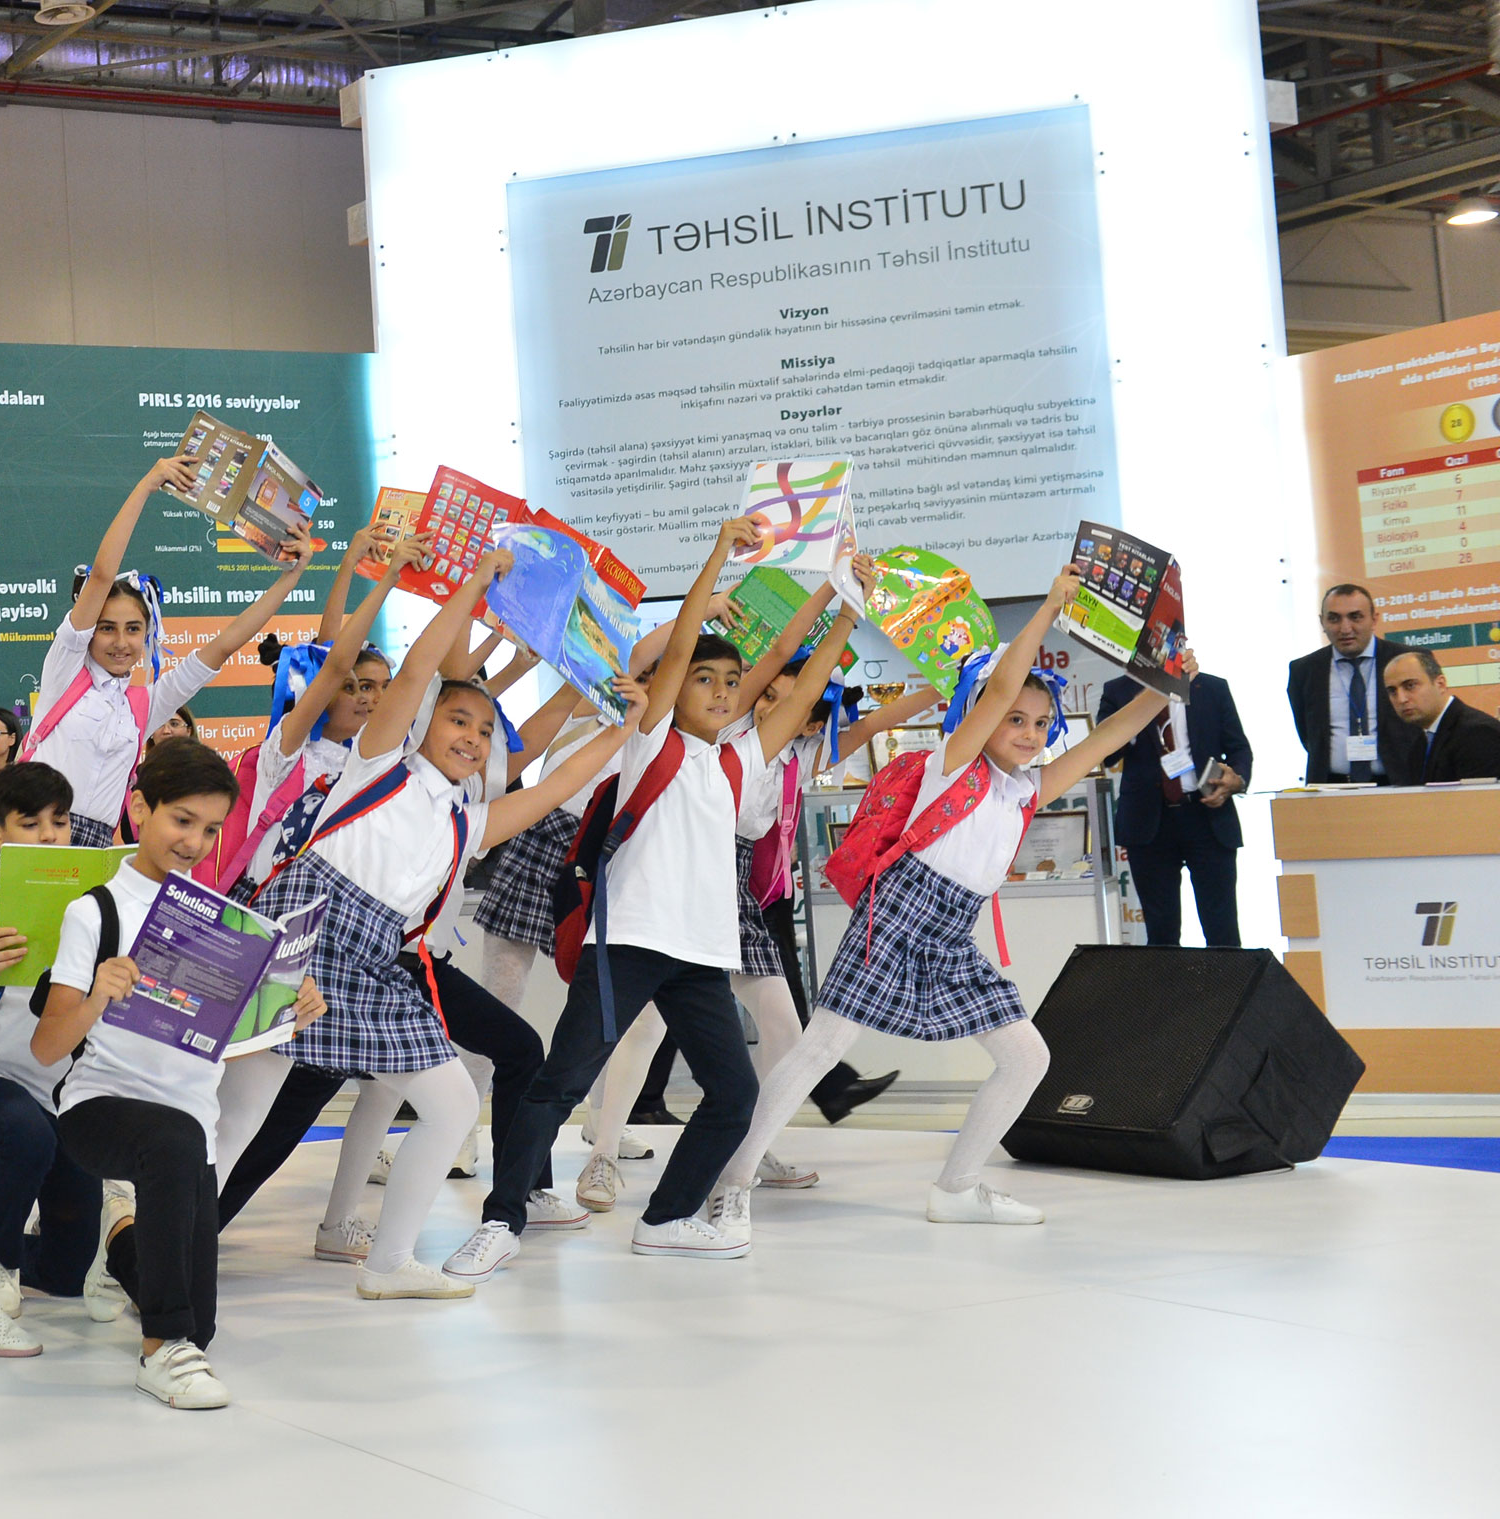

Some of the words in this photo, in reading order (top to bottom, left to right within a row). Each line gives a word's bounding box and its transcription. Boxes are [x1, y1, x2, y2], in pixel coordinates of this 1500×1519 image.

[647, 207, 794, 255] TƏHSİL
[805, 179, 1026, 236] İNSTİTUTU
[588, 278, 702, 304] Azərbaycan
[710, 258, 871, 289] Respublikasının
[876, 245, 940, 269] Təhsil
[947, 236, 1030, 261] İnstitutu
[779, 306, 829, 320] Vizyon
[598, 343, 635, 355] Təhsilin
[637, 342, 653, 351] hər
[656, 339, 669, 349] bir
[672, 334, 726, 347] vətəndaşın
[728, 327, 772, 343] gündəlik
[774, 322, 822, 337] həyatının
[824, 320, 838, 330] bir
[840, 315, 887, 328] hissəsinə
[889, 309, 951, 324] çevrilməsini
[953, 305, 985, 315] təmin
[987, 298, 1026, 311] etmək.
[780, 354, 835, 370] Missiya
[1334, 365, 1394, 383] Azərbaycan
[1395, 347, 1478, 371] məktəblilərinin
[558, 392, 632, 408] Fəaliyyətimizdə
[634, 391, 656, 400] əsas
[658, 385, 697, 398] məqsəd
[699, 382, 736, 394] təhsilin
[738, 375, 779, 389] müxtəlif
[782, 370, 840, 385] sahələrində
[842, 362, 915, 378] elmi-pedaqoji
[917, 356, 976, 370] tədqiqatlar
[978, 349, 1035, 365] aparmaqla
[1038, 345, 1078, 357] təhsilin
[1401, 374, 1424, 386] əldə
[680, 397, 724, 409] inkişafını
[727, 395, 758, 404] nəzəri
[759, 393, 772, 401] və
[774, 387, 813, 402] praktiki
[815, 382, 863, 395] cəhətdən
[865, 380, 896, 390] təmin
[898, 373, 947, 387] etməkdir.
[138, 393, 183, 408] PIRLS
[187, 393, 222, 408] 2016
[226, 395, 301, 413] səviyyələr
[780, 404, 842, 422] Dəyərlər
[548, 447, 584, 460] Şagirdə
[586, 443, 616, 456] (təhsil
[618, 441, 648, 452] alana)
[650, 437, 695, 451] şəxsiyyət
[697, 434, 719, 444] kimi
[721, 430, 772, 444] yanaşmaq
[774, 428, 786, 437] və
[788, 425, 810, 435] onu
[811, 422, 838, 433] təlim
[847, 418, 884, 429] tərbiyə
[886, 411, 946, 428] prossesinin
[948, 402, 1034, 419] bərabərhüquqlu
[1036, 397, 1096, 411] subyektinə
[1451, 419, 1462, 428] 28
[868, 440, 935, 455] hərəkətverici
[937, 435, 994, 451] qüvvəsidir,
[997, 430, 1045, 445] şəxsiyyət
[1445, 454, 1469, 468] Qızıl
[1379, 467, 1405, 478] Fənn
[1371, 483, 1417, 497] Riyaziyyat
[304, 498, 311, 506] 5
[1382, 500, 1408, 511] Fizika
[184, 511, 200, 519] (16%)
[1382, 515, 1411, 527] Kimya
[318, 520, 335, 529] 550
[1377, 530, 1419, 544] Biologiya
[155, 545, 187, 553] Mükəmməl
[189, 545, 202, 553] (2%)
[332, 542, 348, 551] 625
[1118, 542, 1132, 553] TEST
[1458, 552, 1473, 564] 28
[1381, 612, 1409, 623] Fənn
[0, 632, 54, 643] Mükəmməl
[1404, 632, 1452, 647] Medallar
[222, 725, 255, 740] üçün
[72, 867, 79, 878] 2
[165, 883, 220, 921] Solutions
[1364, 954, 1426, 970] TƏHSİL
